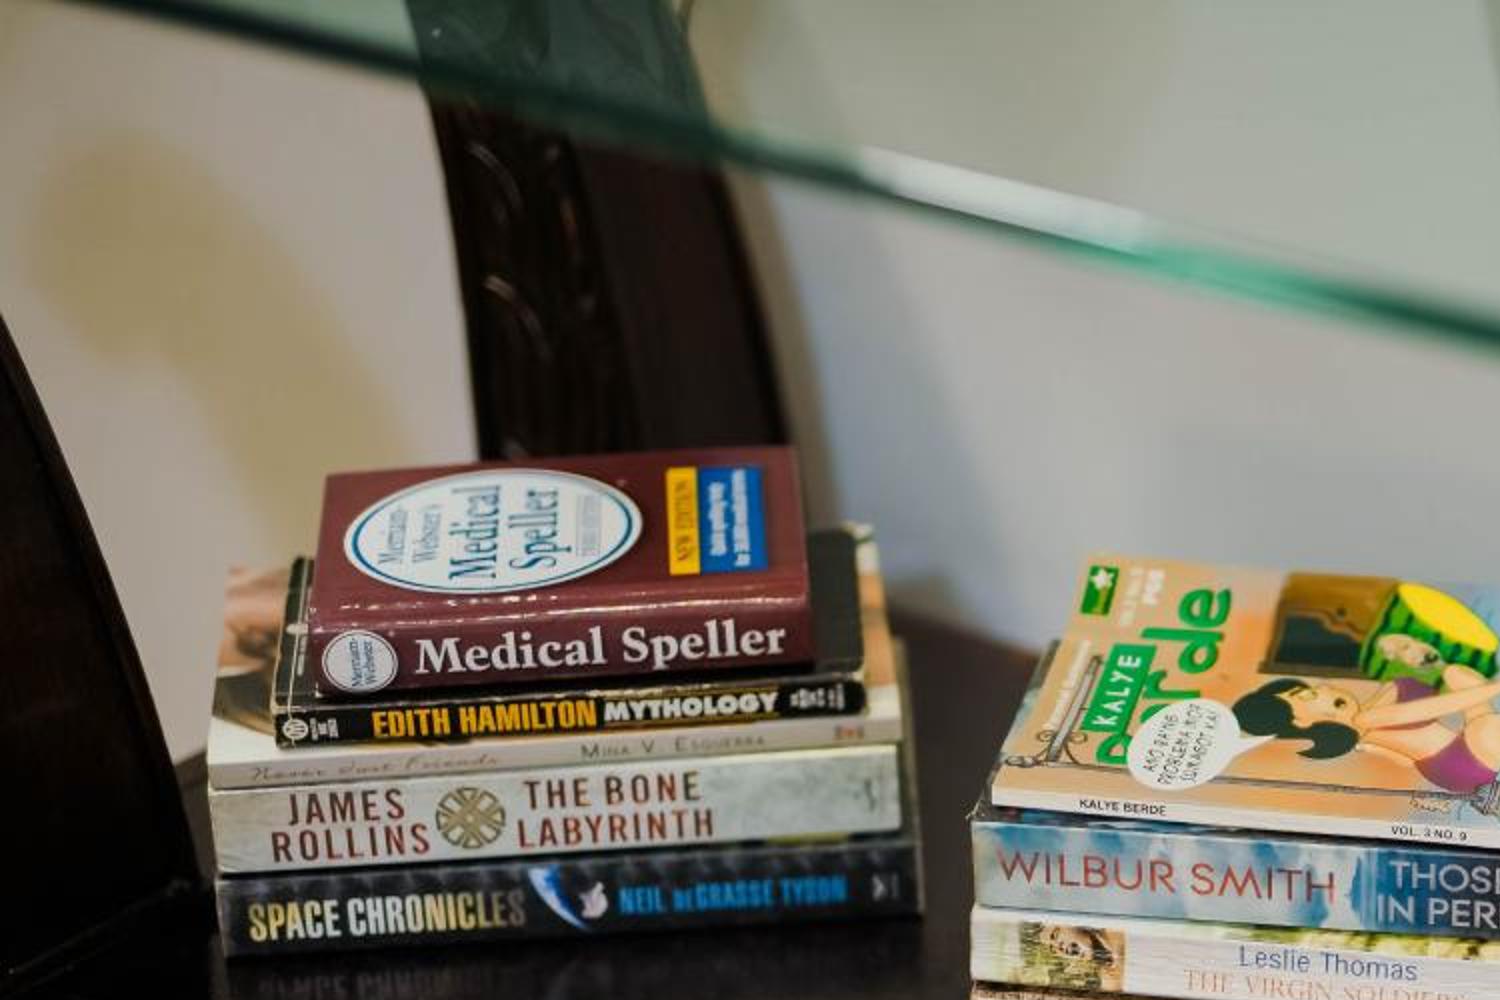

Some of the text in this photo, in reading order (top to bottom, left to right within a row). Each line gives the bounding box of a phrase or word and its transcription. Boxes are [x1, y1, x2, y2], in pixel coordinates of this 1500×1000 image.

[448, 485, 501, 580] Medical
[508, 489, 572, 569] Speller
[415, 618, 787, 675] Medical Speller
[1091, 654, 1142, 727] KALYE
[371, 706, 450, 738] EDITH
[459, 698, 597, 736] HAMILTON
[604, 690, 779, 722] MYTHOLOGY
[288, 787, 406, 827] JAMES
[523, 770, 701, 811] THE BONE
[1079, 799, 1167, 817] KALYE BERDE
[271, 823, 432, 863] ROLLINS
[516, 807, 714, 849] LABYRINTH
[617, 883, 663, 914] NEIL
[779, 874, 849, 906] TYSON
[996, 849, 1336, 904] WILBUR SMITH
[249, 888, 527, 942] SPACE CHRONICLES
[1376, 894, 1415, 925] IN
[1184, 967, 1233, 995] THE
[1239, 944, 1419, 982] Leslie Thomas
